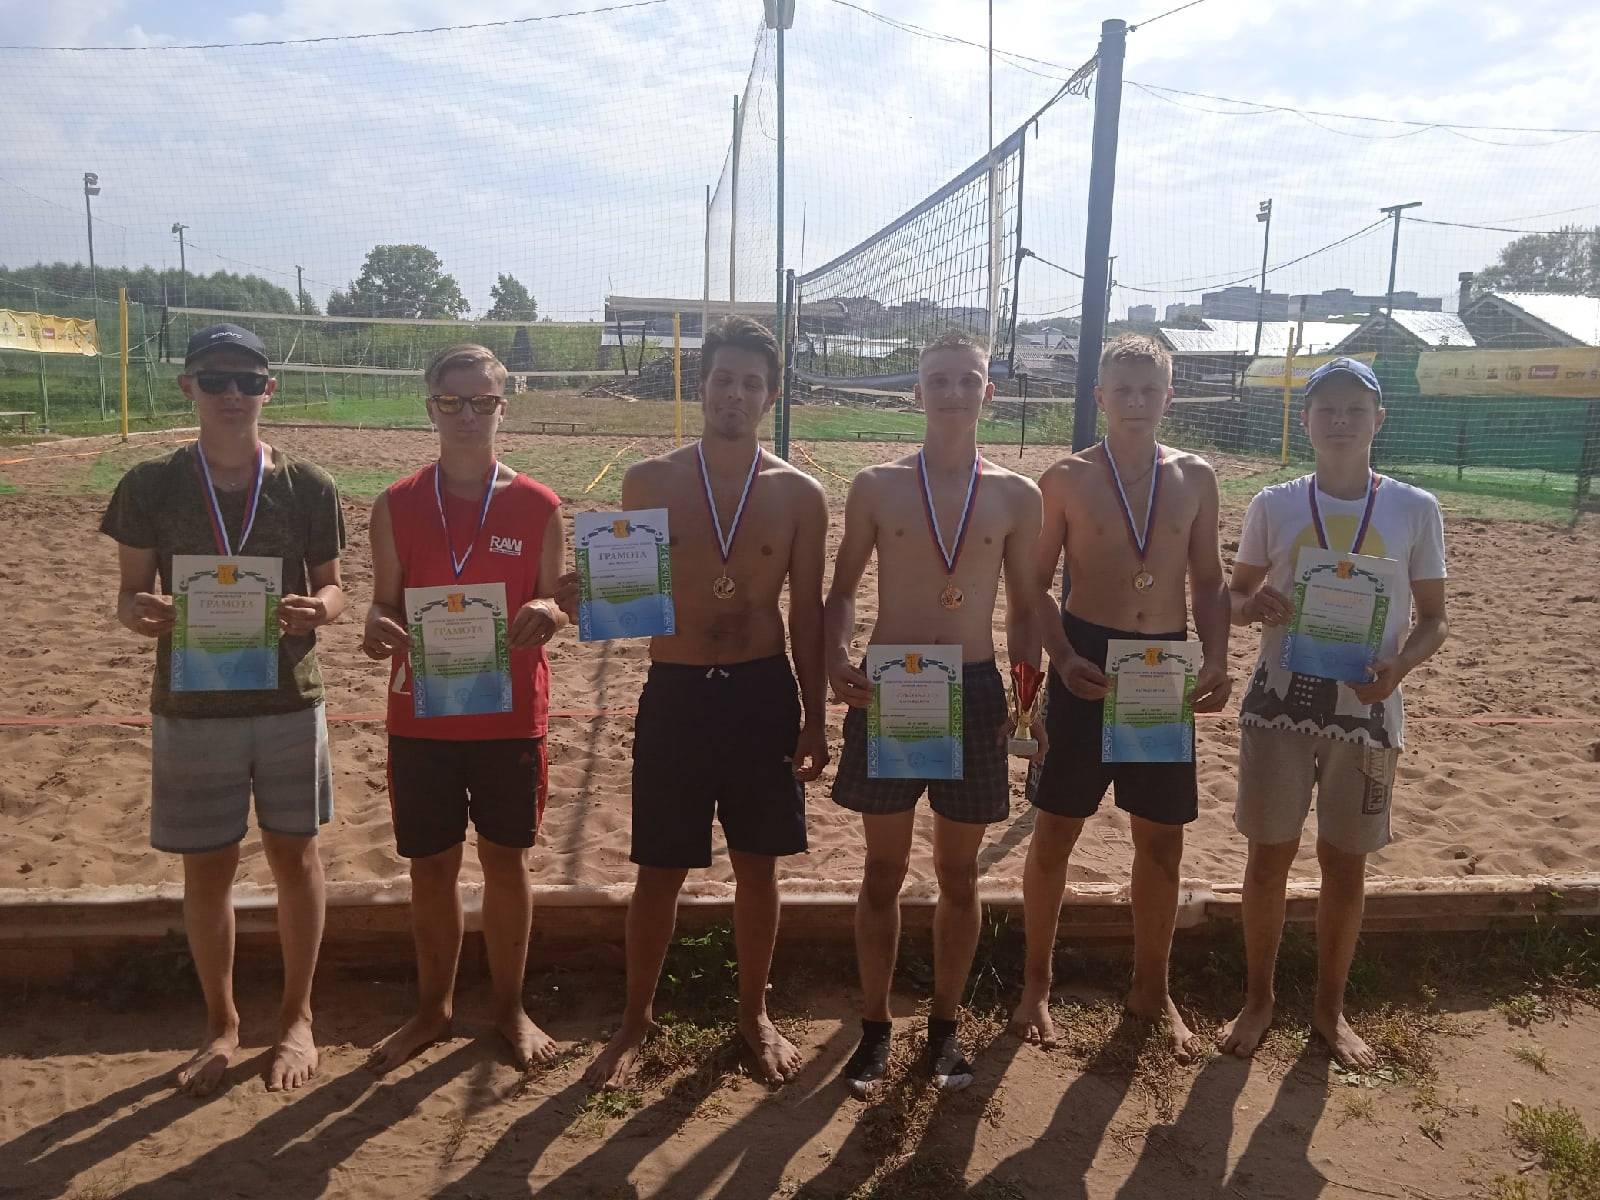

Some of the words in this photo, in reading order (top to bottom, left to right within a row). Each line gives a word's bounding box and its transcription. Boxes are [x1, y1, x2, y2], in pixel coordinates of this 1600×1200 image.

[490, 535, 523, 551] RAW
[599, 551, 648, 561] ГРАМОТА
[199, 600, 255, 609] ГРАМОТА
[434, 626, 484, 636] ГРАМОТА
